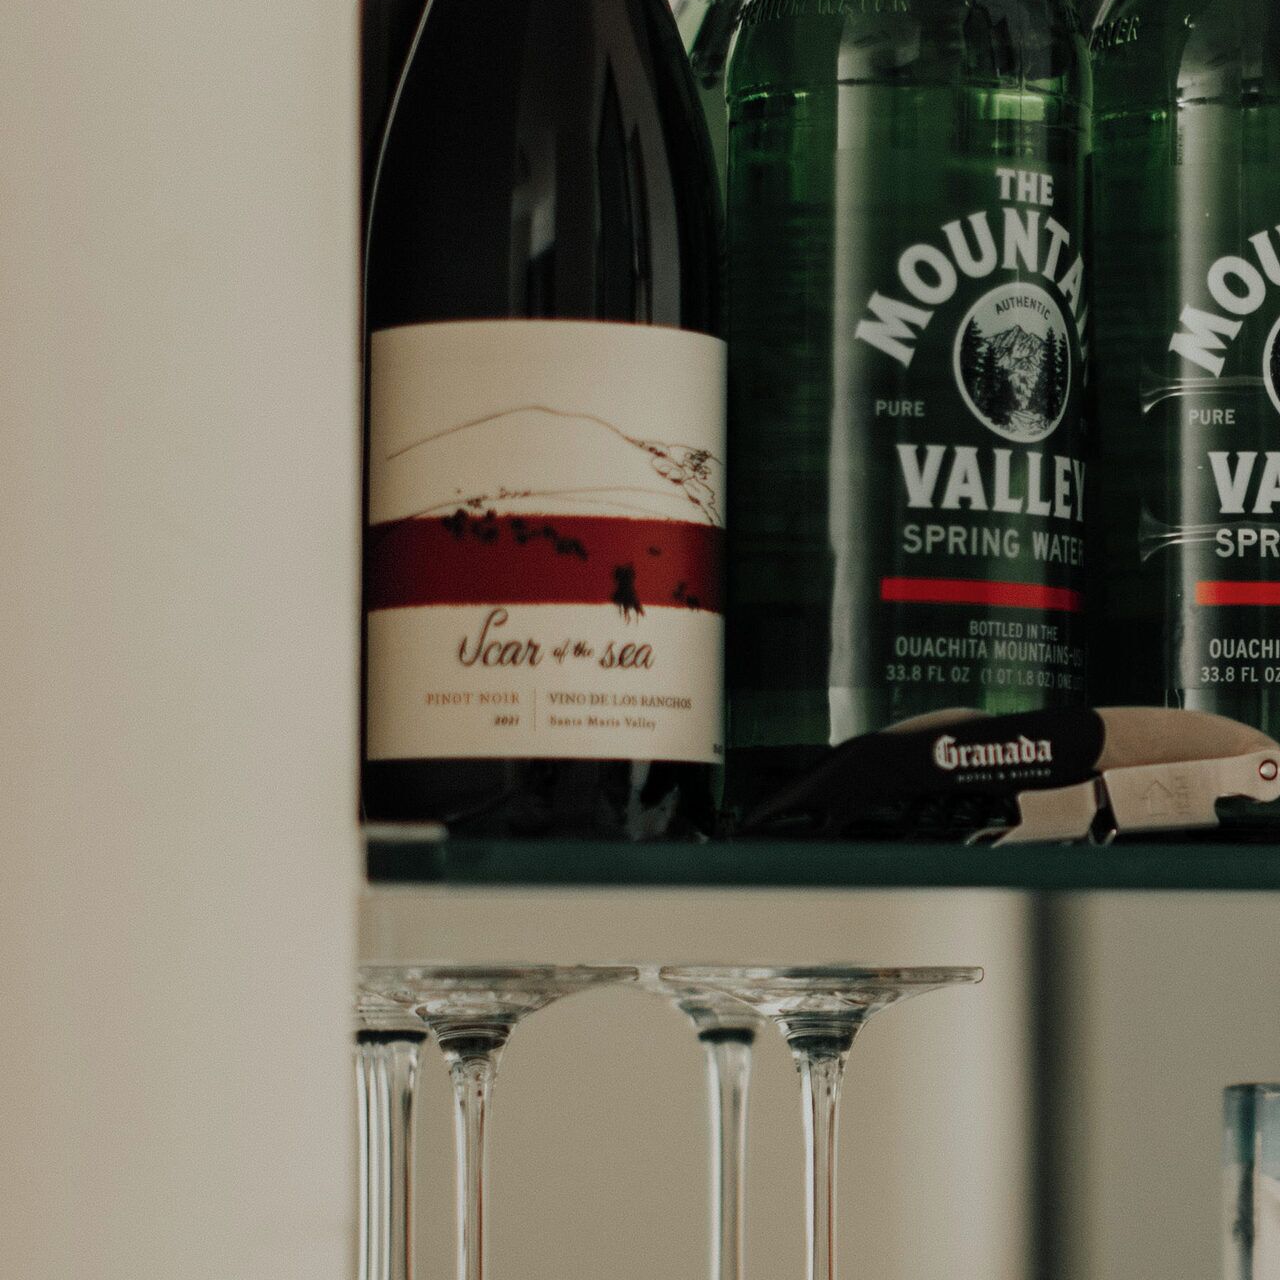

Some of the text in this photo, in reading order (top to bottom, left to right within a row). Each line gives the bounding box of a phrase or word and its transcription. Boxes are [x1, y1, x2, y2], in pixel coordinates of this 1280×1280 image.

[995, 168, 1054, 206] THE
[995, 295, 1051, 321] AUTHENTIC
[875, 400, 925, 417] PURE
[1189, 409, 1236, 425] PURE
[896, 443, 1086, 523] VALLEY
[902, 524, 1020, 558] SPRING
[458, 607, 655, 669] Scar of the sea
[969, 620, 1058, 641] BOTTLED IN THE
[895, 636, 987, 658] OUACHITA
[886, 665, 922, 681] 33.8
[928, 667, 945, 682] FL
[951, 667, 970, 682] OZ
[1200, 666, 1235, 683] 33.8
[1242, 667, 1258, 683] FL
[426, 691, 520, 706] PINOT NOIR
[549, 692, 692, 710] VINO DE LOS RANCHOS
[549, 715, 657, 732] Santa Maria Valley
[934, 734, 1053, 770] Granada
